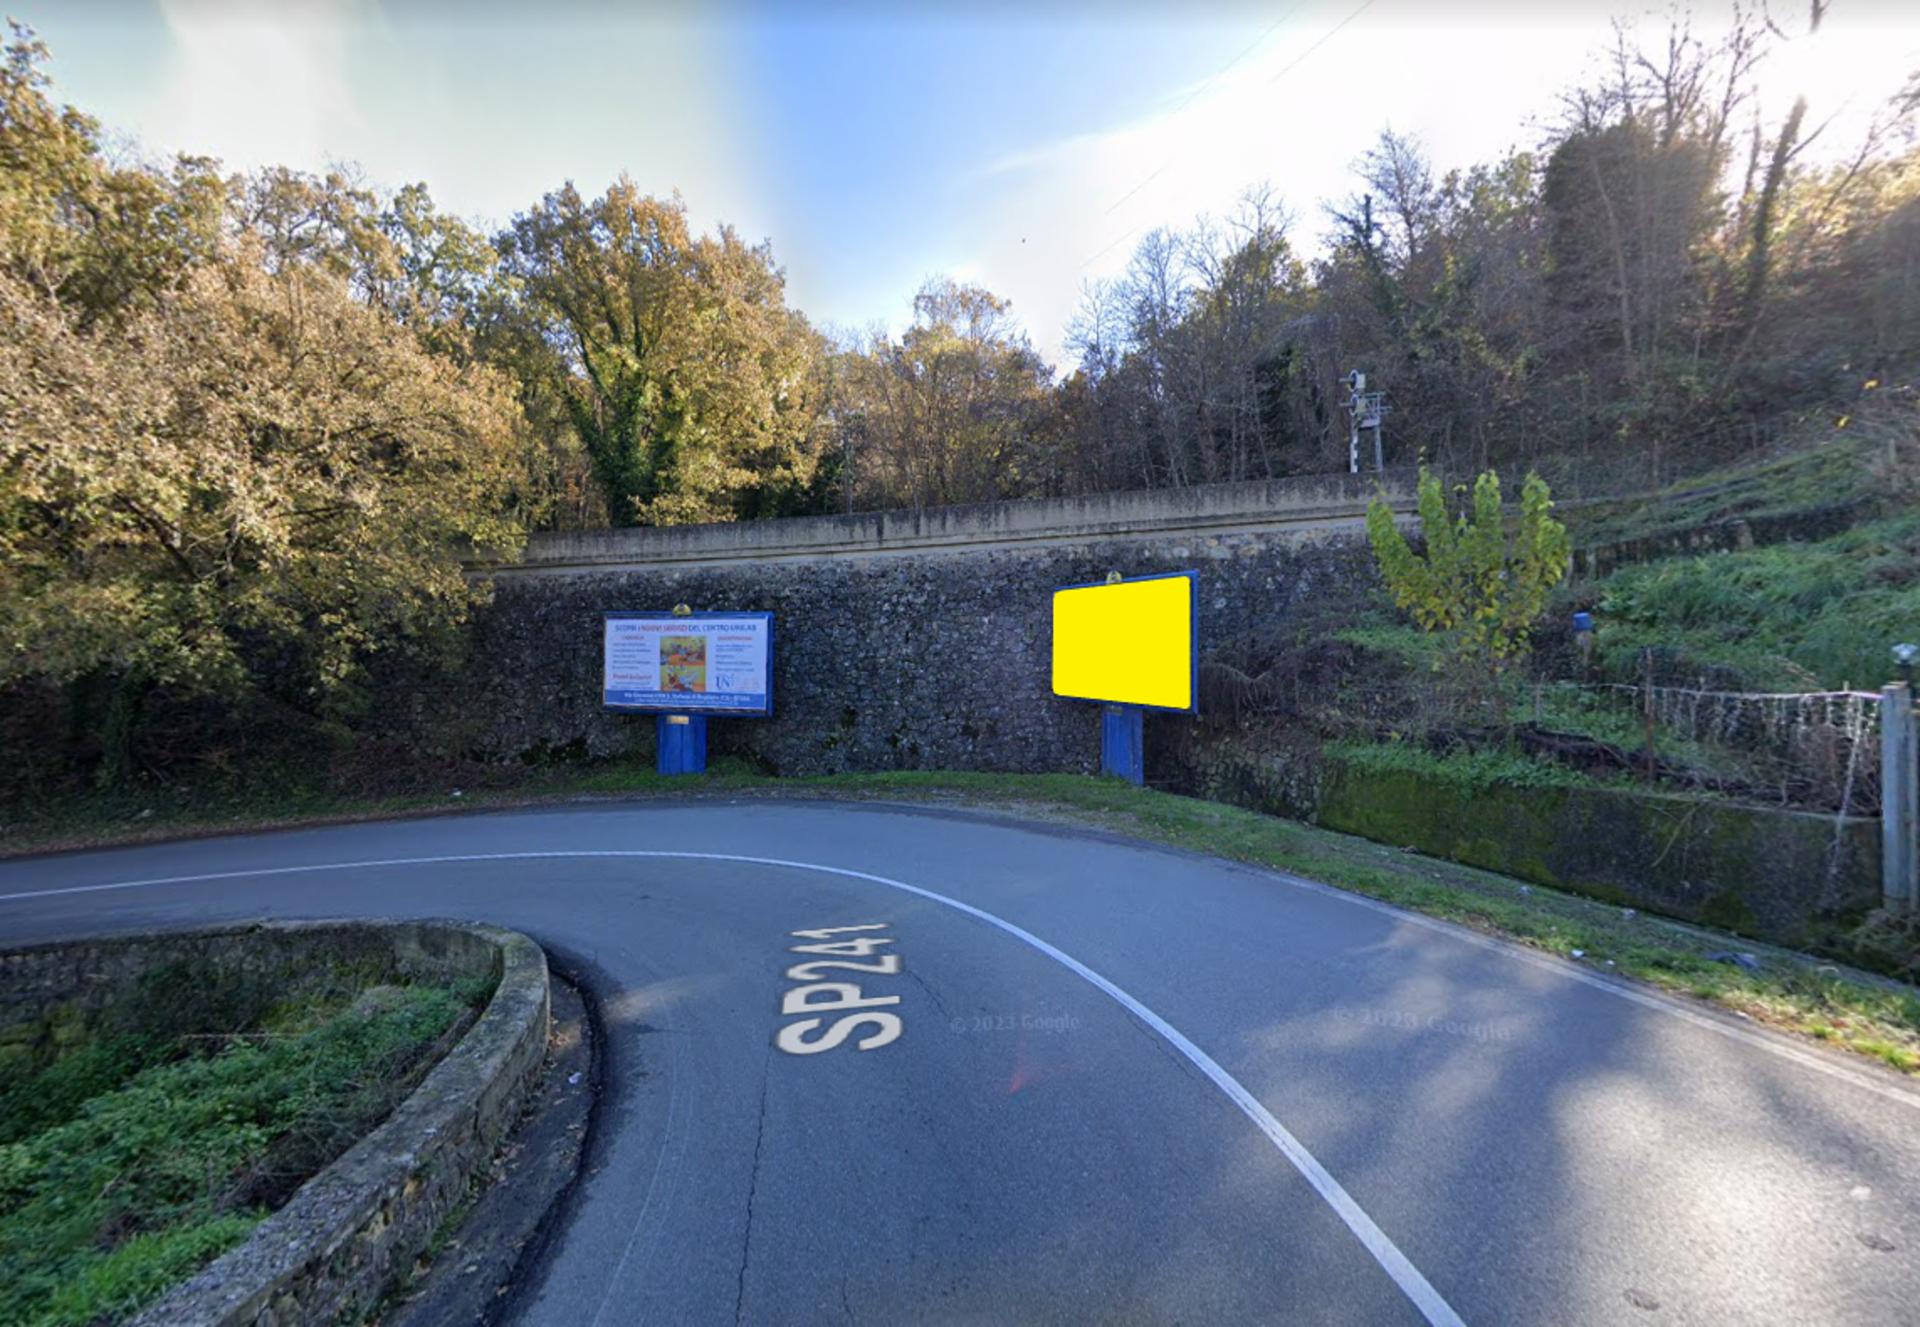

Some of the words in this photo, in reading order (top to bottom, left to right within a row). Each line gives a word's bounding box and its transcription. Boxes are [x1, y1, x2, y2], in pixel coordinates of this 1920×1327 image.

[688, 624, 702, 633] DEL
[703, 624, 729, 633] CENTRO
[777, 923, 903, 1054] SP241
